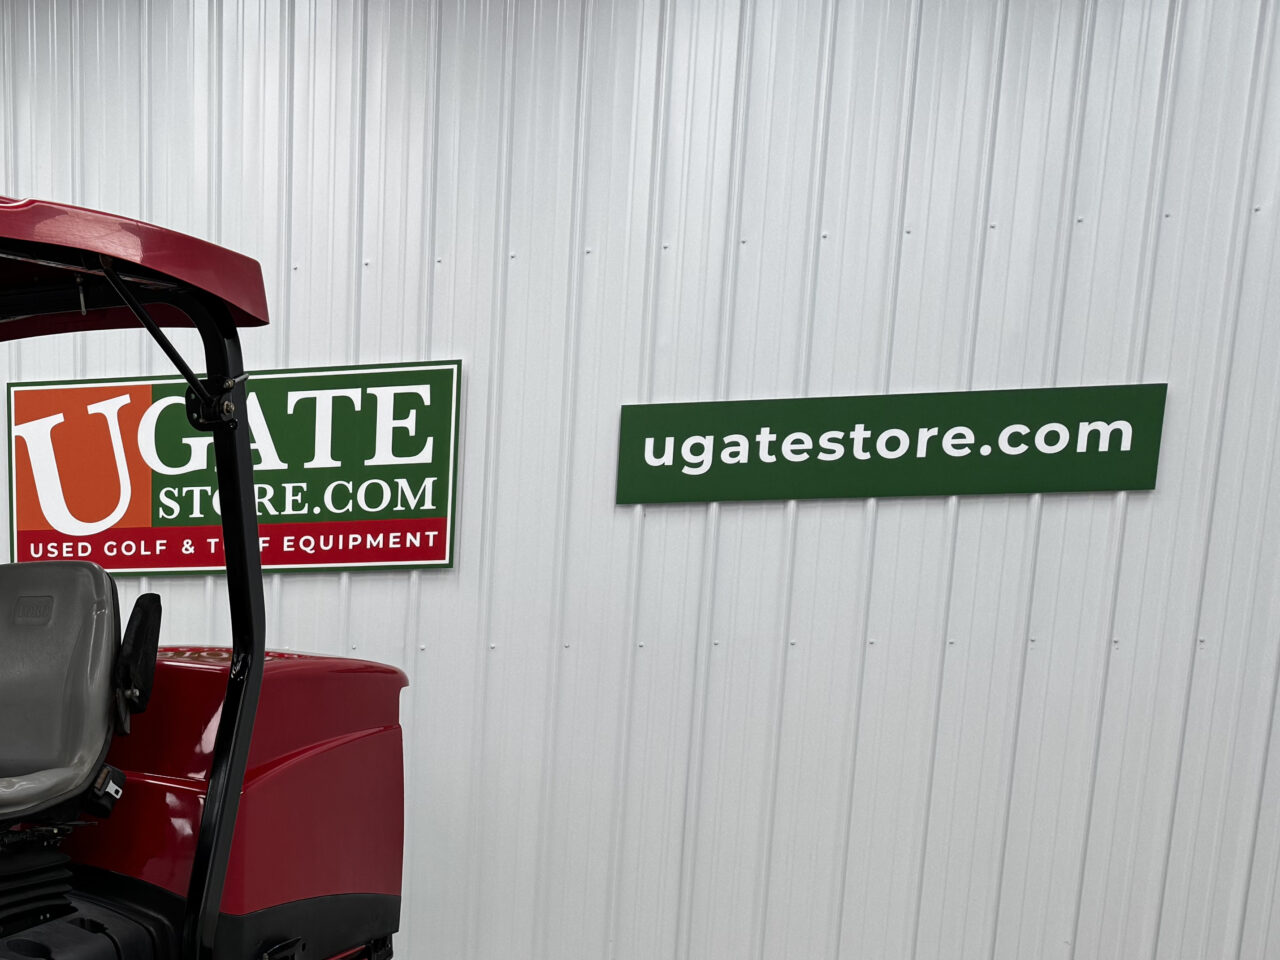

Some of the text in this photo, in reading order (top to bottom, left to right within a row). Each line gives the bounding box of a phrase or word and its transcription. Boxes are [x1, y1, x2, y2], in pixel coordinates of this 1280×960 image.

[643, 418, 1133, 476] ugatestore.com
[158, 477, 438, 519] STRE.COM
[29, 531, 439, 558] USED GOLF & TF EQUIPMENT
